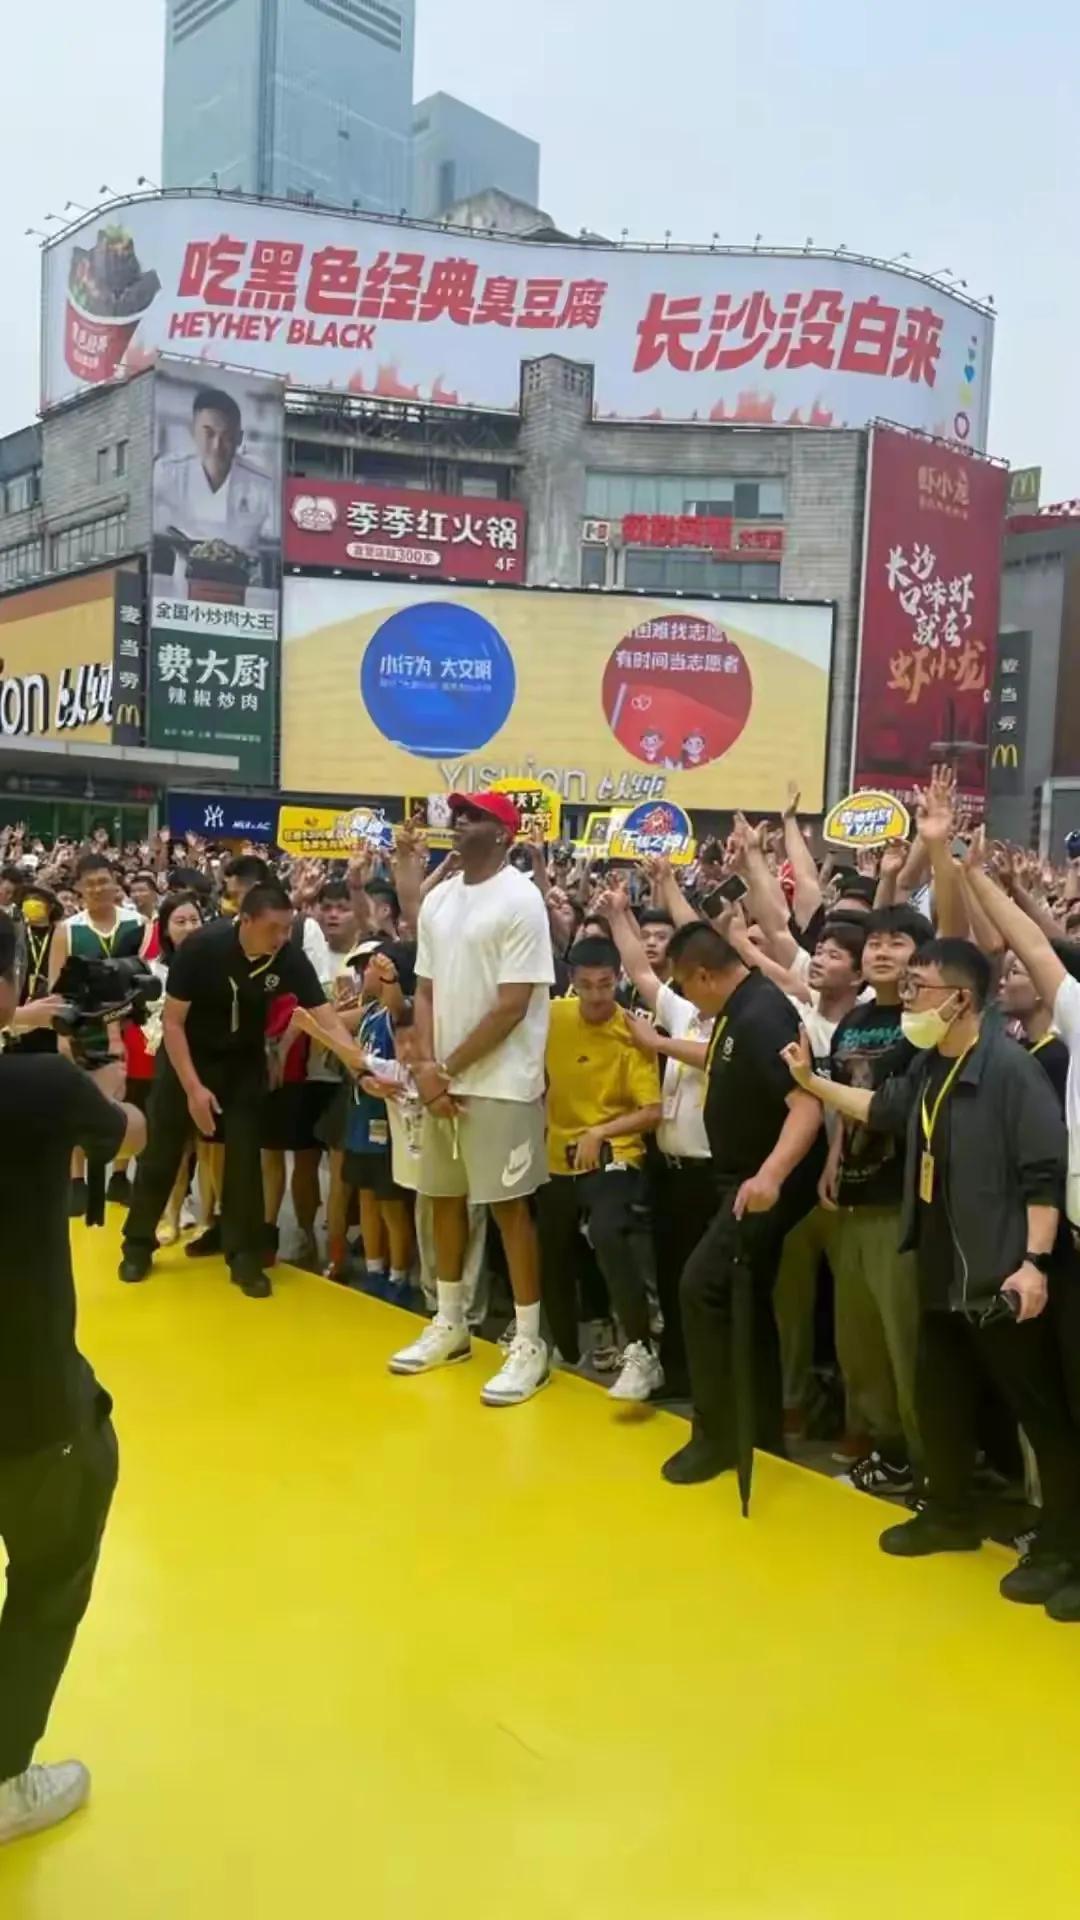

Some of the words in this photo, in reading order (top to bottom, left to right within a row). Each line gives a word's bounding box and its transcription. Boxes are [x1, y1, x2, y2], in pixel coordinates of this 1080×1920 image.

[168, 311, 281, 343] HEYHEY
[286, 320, 377, 350] BLACK
[633, 289, 944, 389] 长沙没白来
[346, 501, 518, 550] 季季红火锅
[494, 556, 517, 572] 4F
[885, 542, 937, 592] 长沙
[156, 601, 275, 631] 全国小炒肉大王
[899, 573, 975, 616] 口味虾
[119, 604, 144, 690] 麦当劳
[157, 642, 270, 691] 费大厨
[379, 654, 432, 677] 小行为
[440, 658, 493, 680] 大文明
[615, 650, 740, 674] 有时间当志愿者
[0, 672, 46, 735] on
[167, 686, 259, 712] 辣椒炒肉
[998, 657, 1020, 732] 麦当劳
